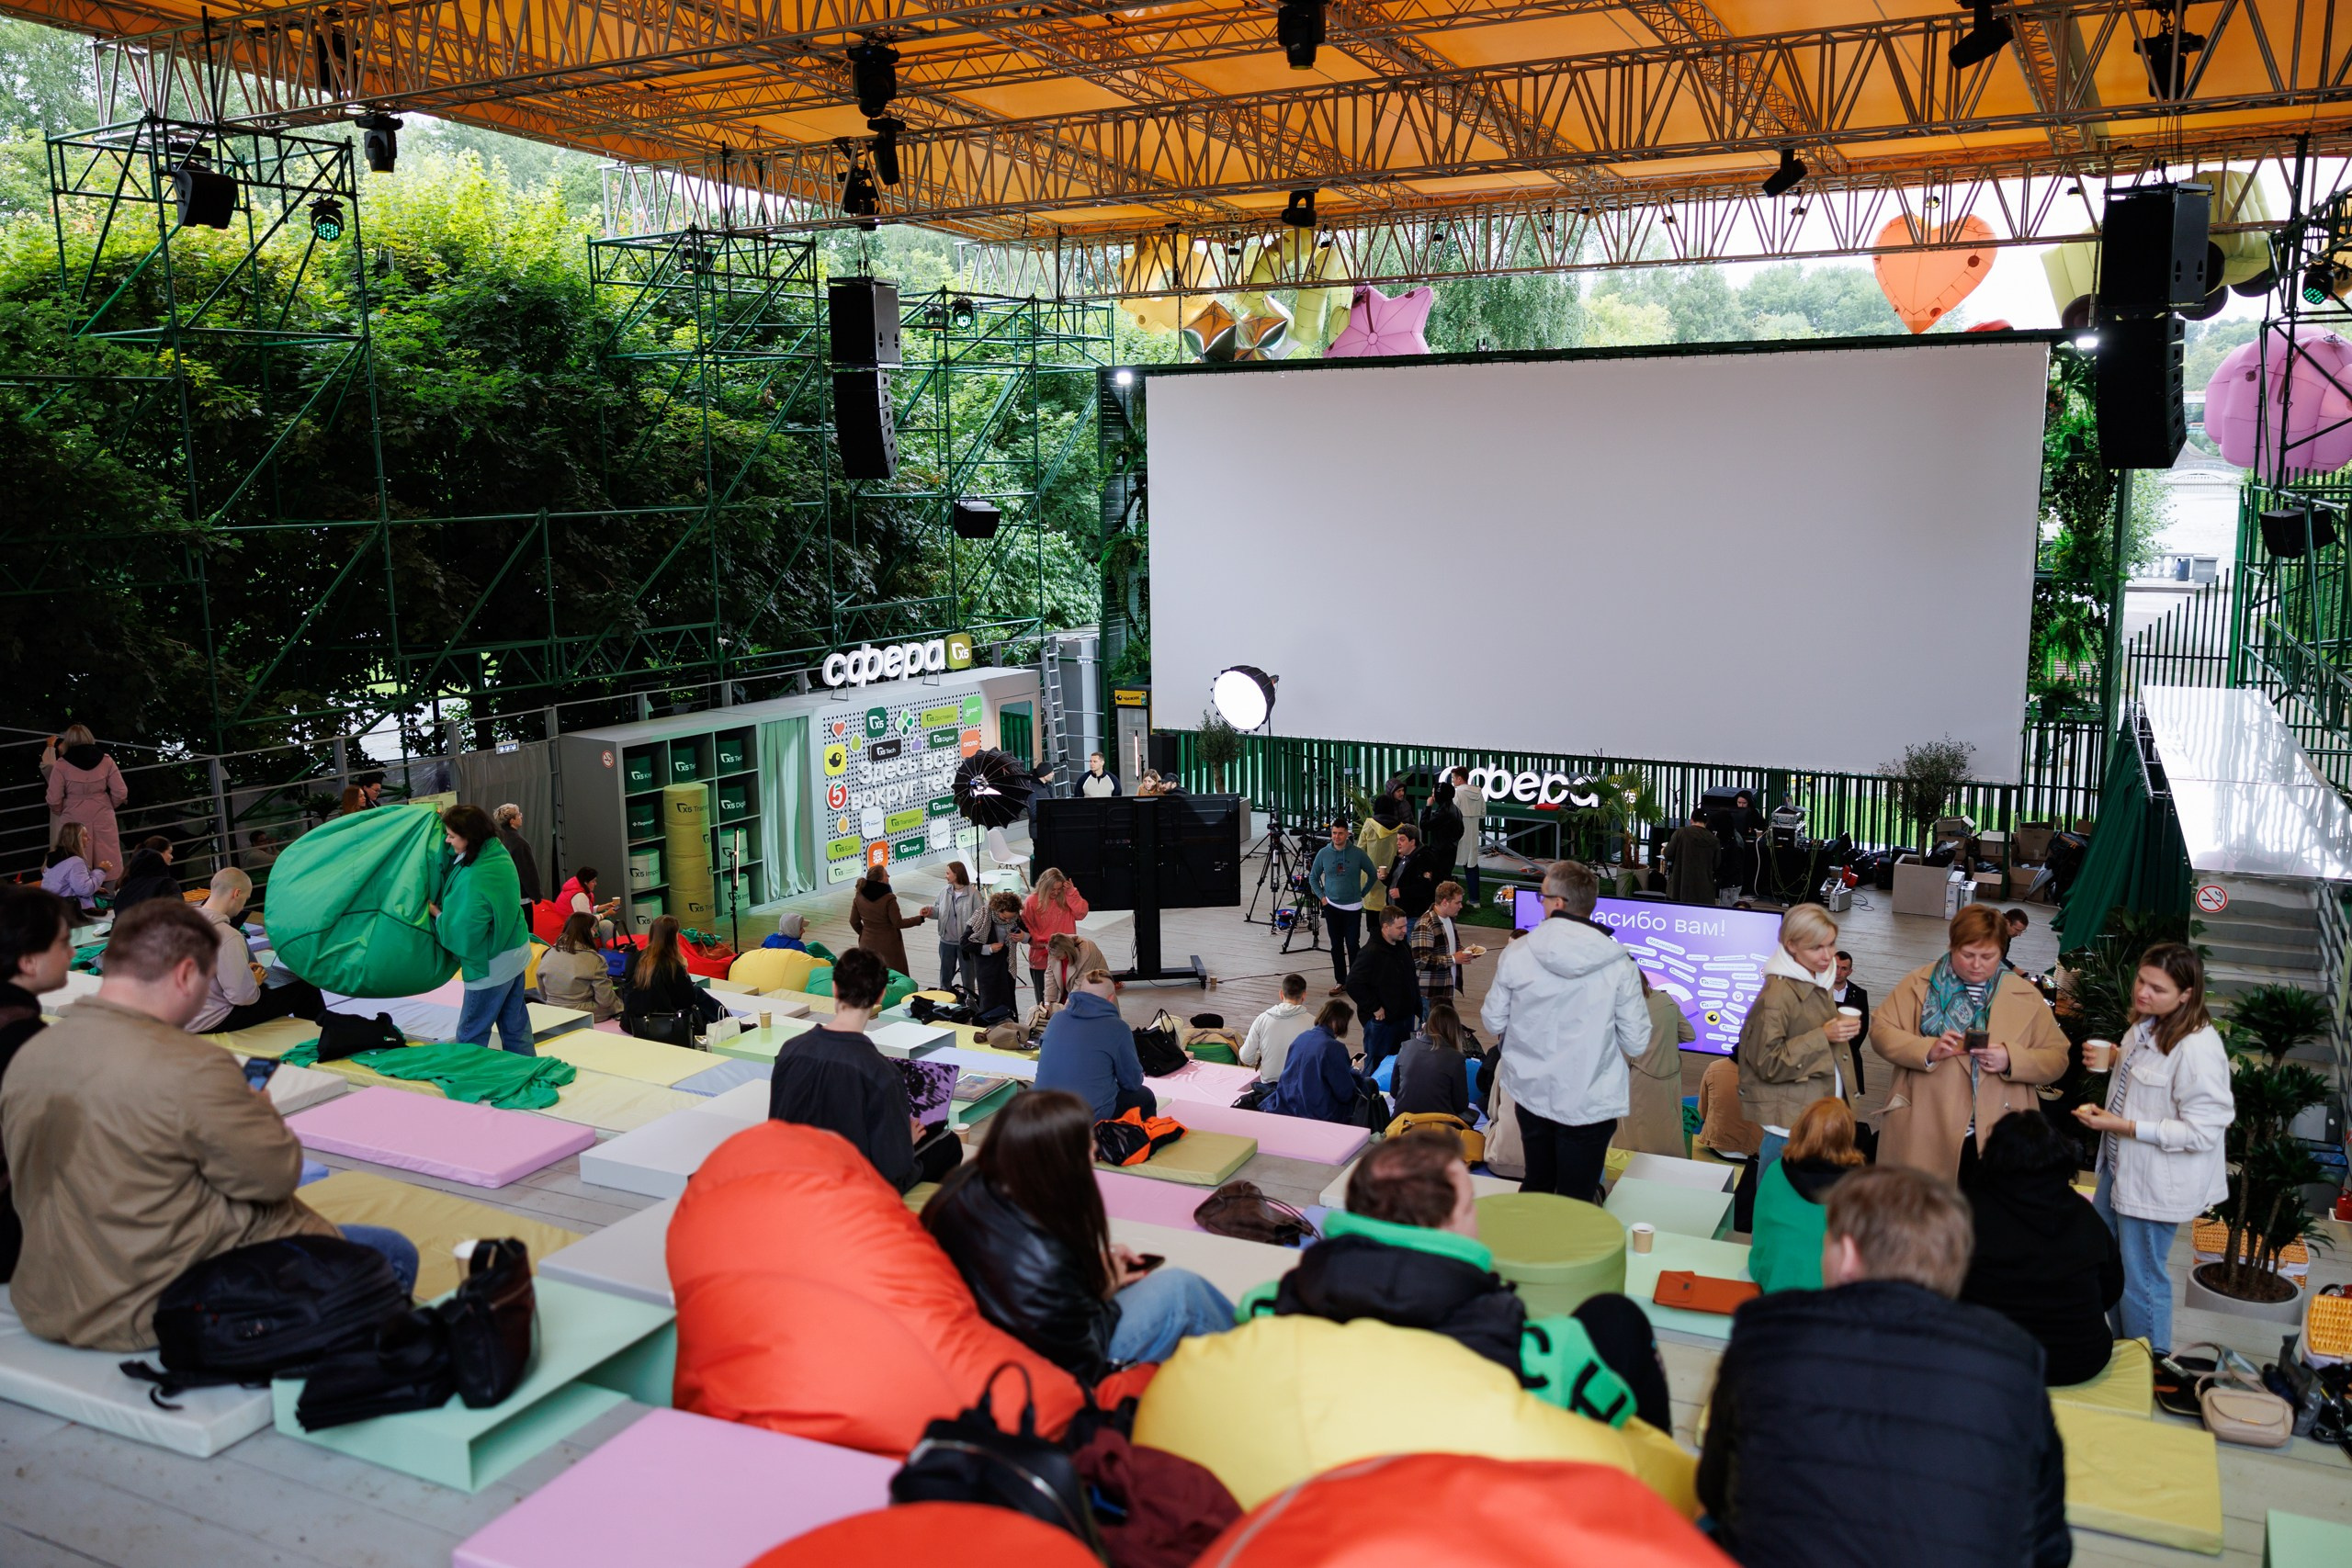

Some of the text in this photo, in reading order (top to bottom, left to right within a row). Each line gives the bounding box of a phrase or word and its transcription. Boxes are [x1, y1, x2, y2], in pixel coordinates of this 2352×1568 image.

[822, 639, 945, 687] сфера
[857, 750, 956, 785] Здесь все
[850, 765, 956, 811] вокруг теб
[1590, 910, 1725, 937] асибо вам!
